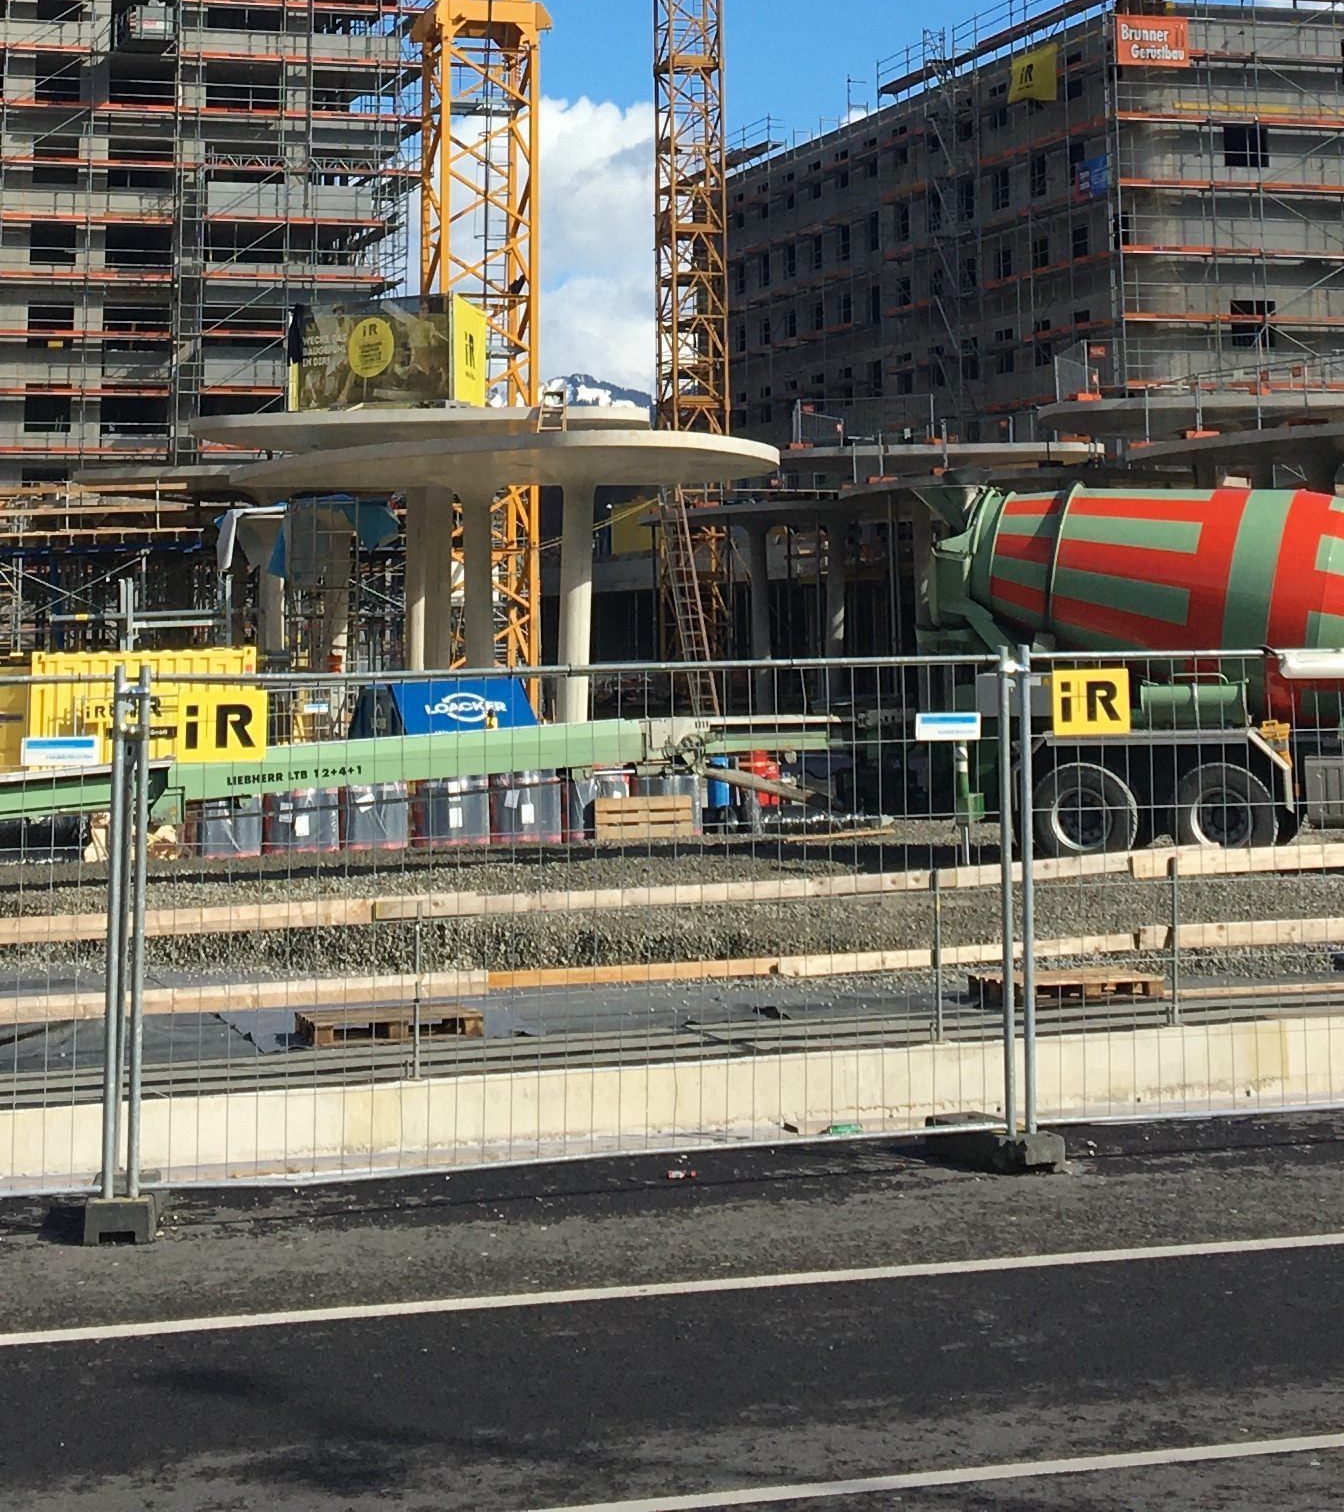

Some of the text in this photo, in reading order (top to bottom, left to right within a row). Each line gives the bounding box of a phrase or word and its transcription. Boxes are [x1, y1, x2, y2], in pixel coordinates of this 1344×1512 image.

[1120, 23, 1169, 42] Brunner
[1130, 44, 1185, 61] Gerüstbau
[227, 772, 284, 786] LIEBHERR
[288, 770, 308, 781] LTB
